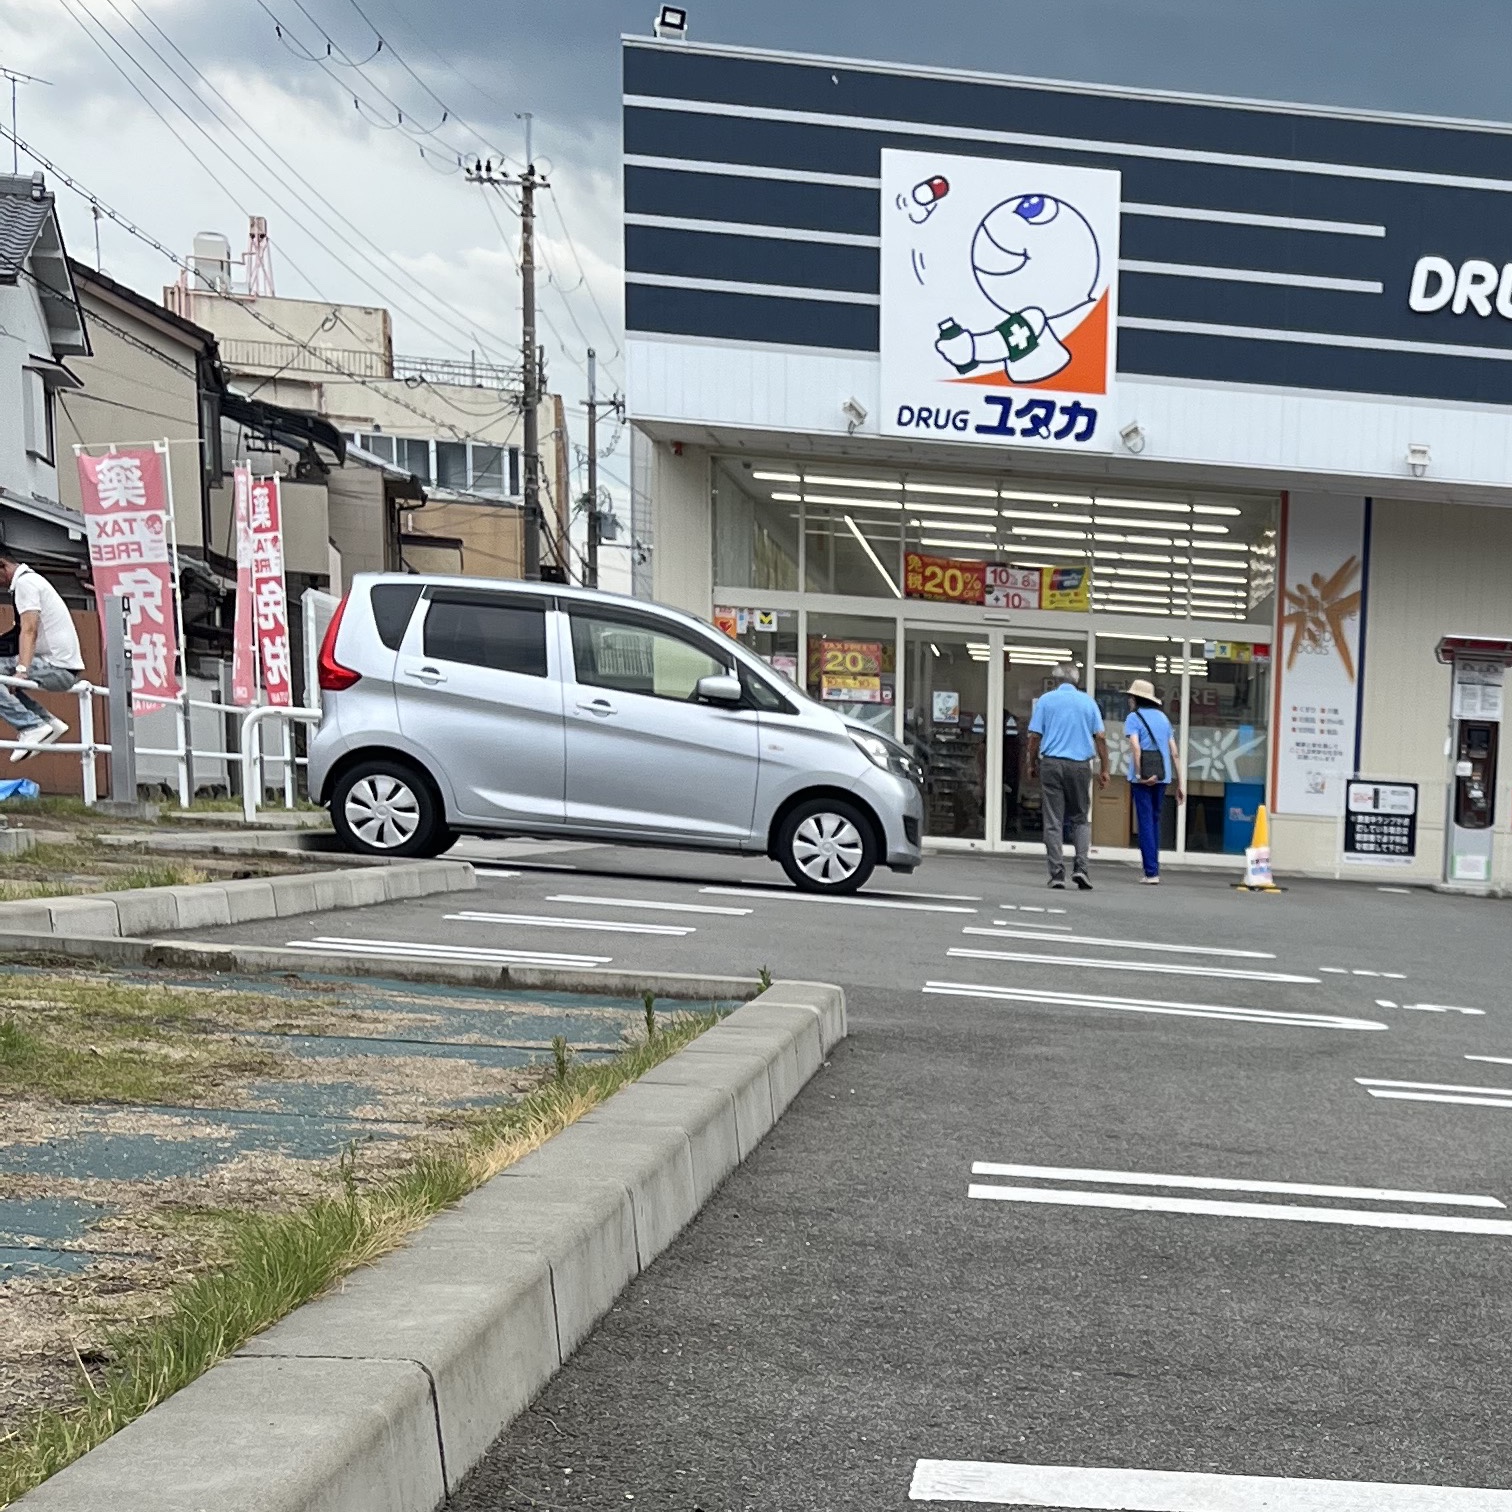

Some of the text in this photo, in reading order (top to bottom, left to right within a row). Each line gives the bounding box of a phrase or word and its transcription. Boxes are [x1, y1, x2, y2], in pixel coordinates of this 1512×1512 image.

[897, 395, 1098, 441] DRUG ユタカ
